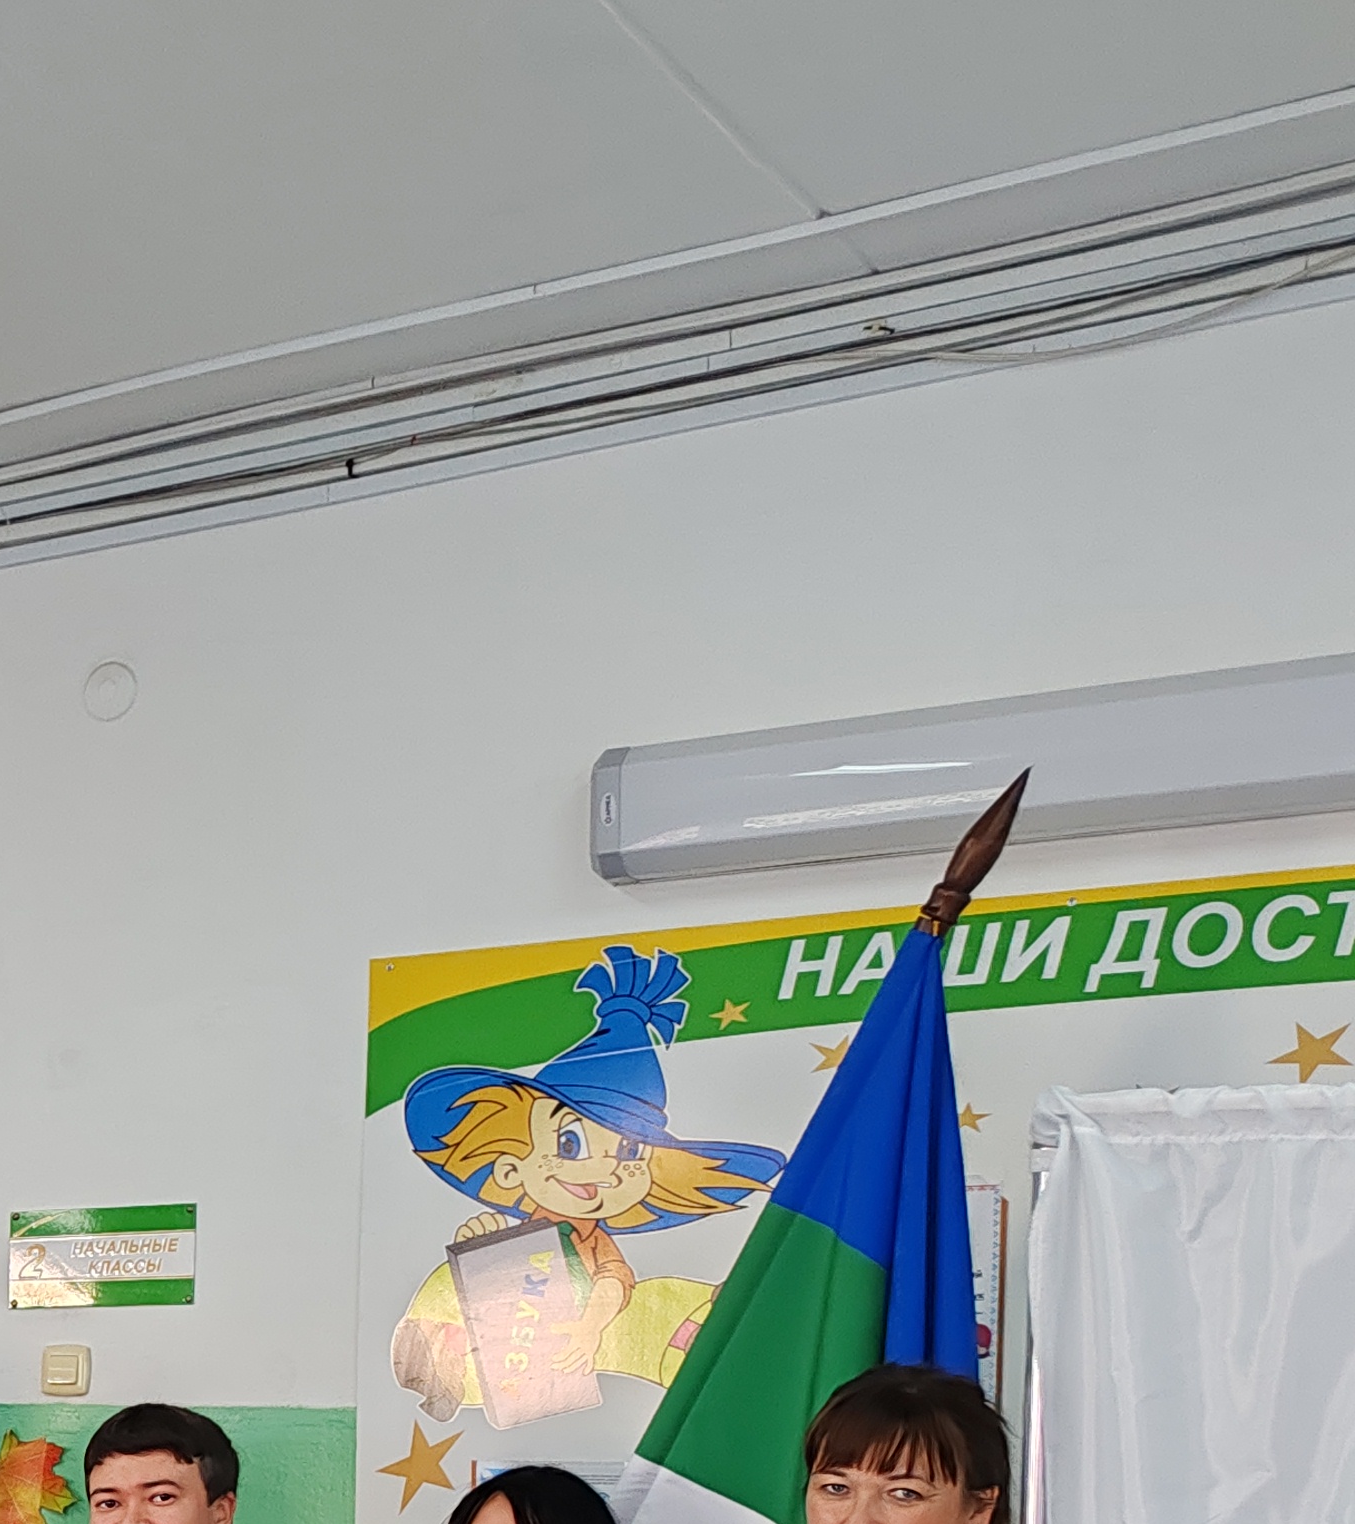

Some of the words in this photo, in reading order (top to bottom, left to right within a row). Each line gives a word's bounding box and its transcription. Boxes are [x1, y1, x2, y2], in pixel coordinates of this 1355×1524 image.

[777, 914, 1072, 1000] НАШИ
[18, 1243, 47, 1279] 2
[71, 1237, 179, 1258] НАЧАЛЬНЫЕ
[87, 1257, 163, 1276] КЛАССЫ
